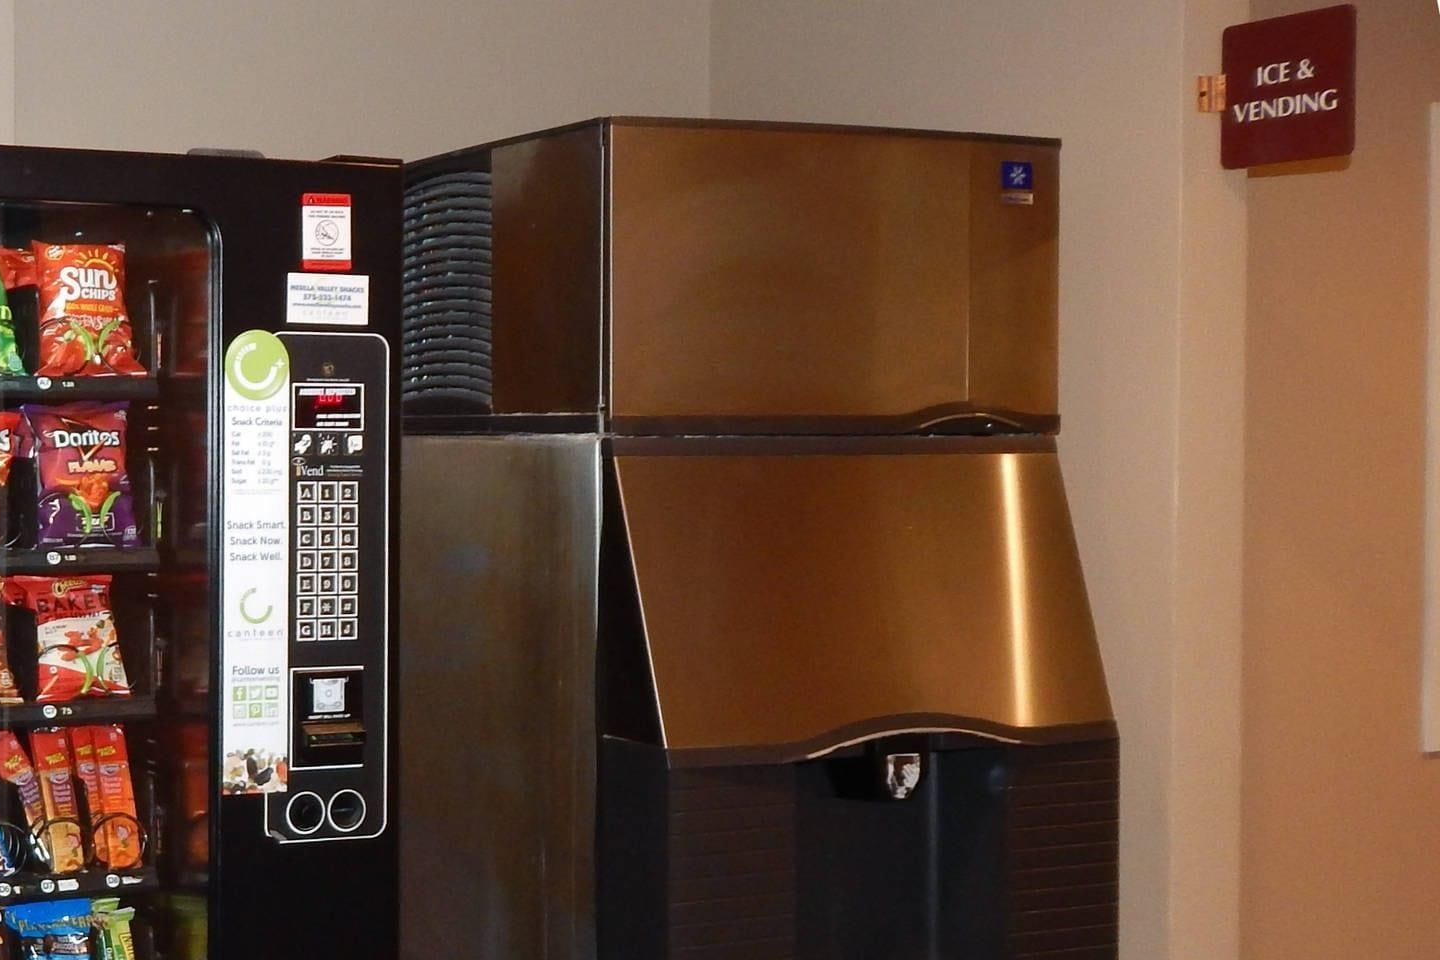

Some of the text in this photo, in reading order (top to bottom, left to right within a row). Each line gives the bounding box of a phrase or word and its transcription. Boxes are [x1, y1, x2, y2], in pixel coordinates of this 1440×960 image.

[1256, 58, 1315, 87] ICE &
[1233, 88, 1338, 123] VENDING
[60, 266, 118, 301] Sun
[80, 287, 117, 301] CHIPS
[232, 417, 252, 426] Snack
[52, 429, 121, 448] Doritos
[227, 520, 286, 530] Snack Smart.
[230, 537, 283, 546] Snack Now.
[229, 552, 282, 562] Snack Well.
[227, 629, 283, 638] canteen
[232, 665, 280, 676] Follow us
